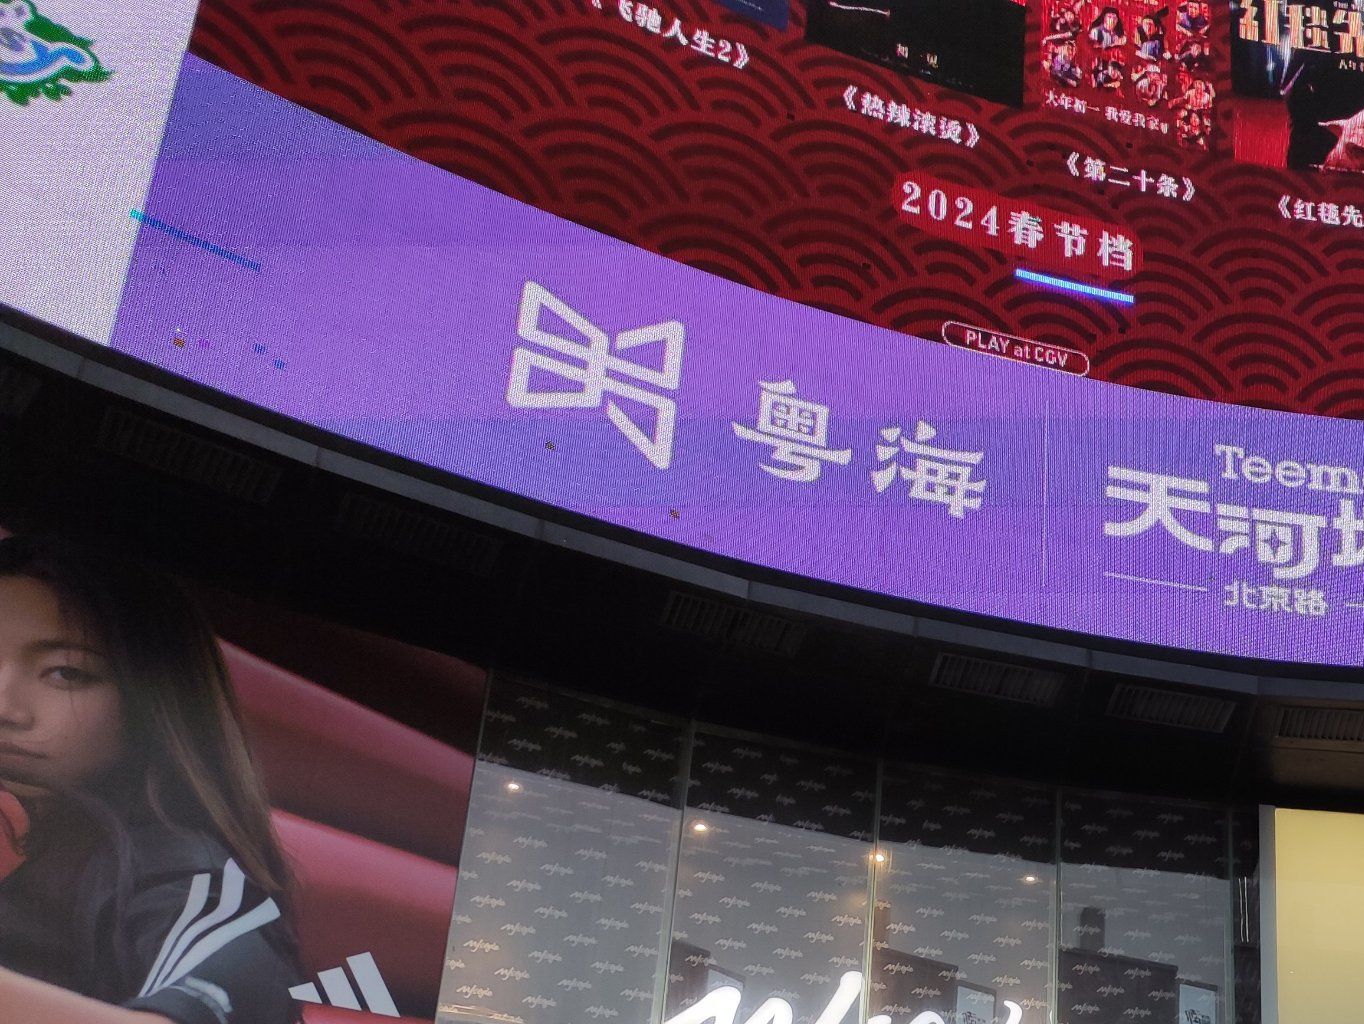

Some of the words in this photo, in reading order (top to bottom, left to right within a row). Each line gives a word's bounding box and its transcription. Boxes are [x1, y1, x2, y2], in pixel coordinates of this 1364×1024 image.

[1066, 151, 1196, 202] 《第二十条》
[900, 182, 1134, 273] 2024春节档
[964, 330, 1011, 356] PLAY
[1033, 346, 1069, 369] CGV
[731, 378, 988, 520] 粤海
[1223, 577, 1328, 617] 北京路
